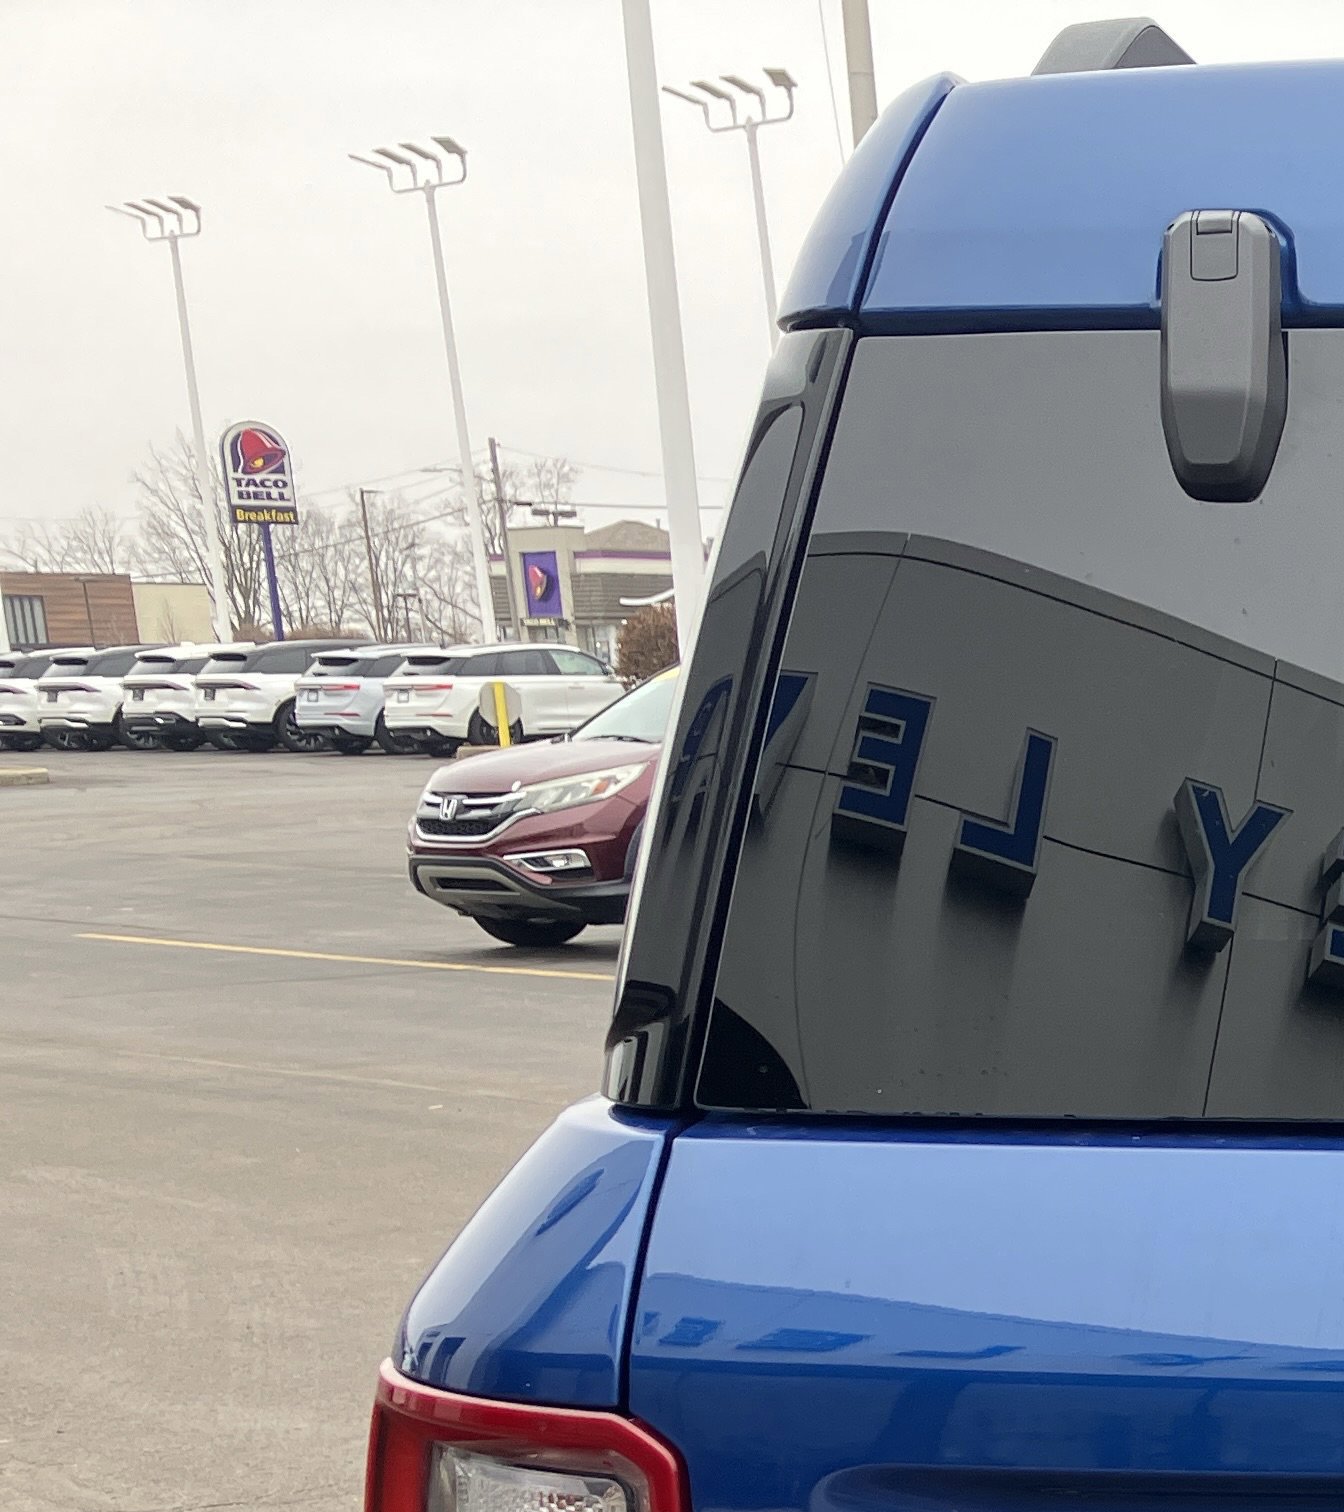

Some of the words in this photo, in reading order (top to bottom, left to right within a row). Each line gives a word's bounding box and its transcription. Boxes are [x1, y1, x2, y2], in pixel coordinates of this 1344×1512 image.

[232, 476, 288, 489] TACO
[237, 490, 291, 501] BELL
[235, 508, 294, 523] Breakfast
